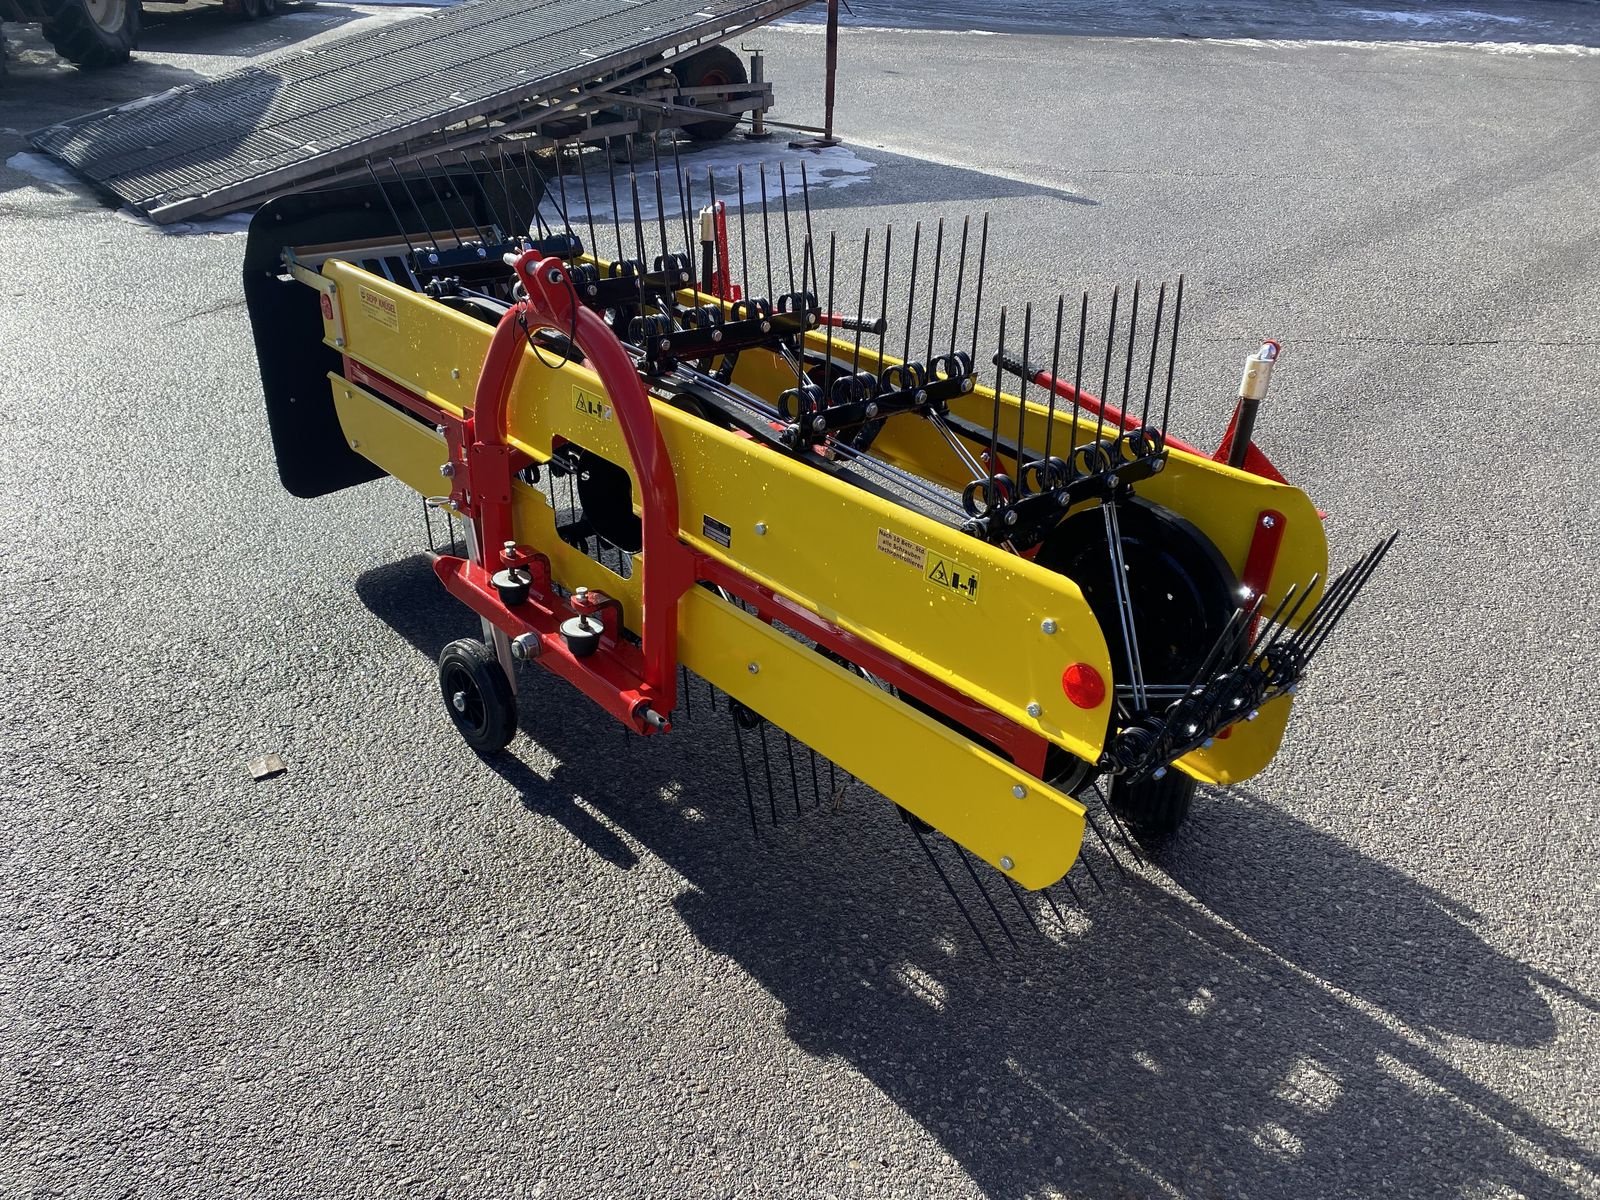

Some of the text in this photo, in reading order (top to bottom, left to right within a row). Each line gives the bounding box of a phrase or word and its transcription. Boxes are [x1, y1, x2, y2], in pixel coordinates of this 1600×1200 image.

[879, 529, 893, 540] Nach
[883, 539, 921, 560] alle Schrauben
